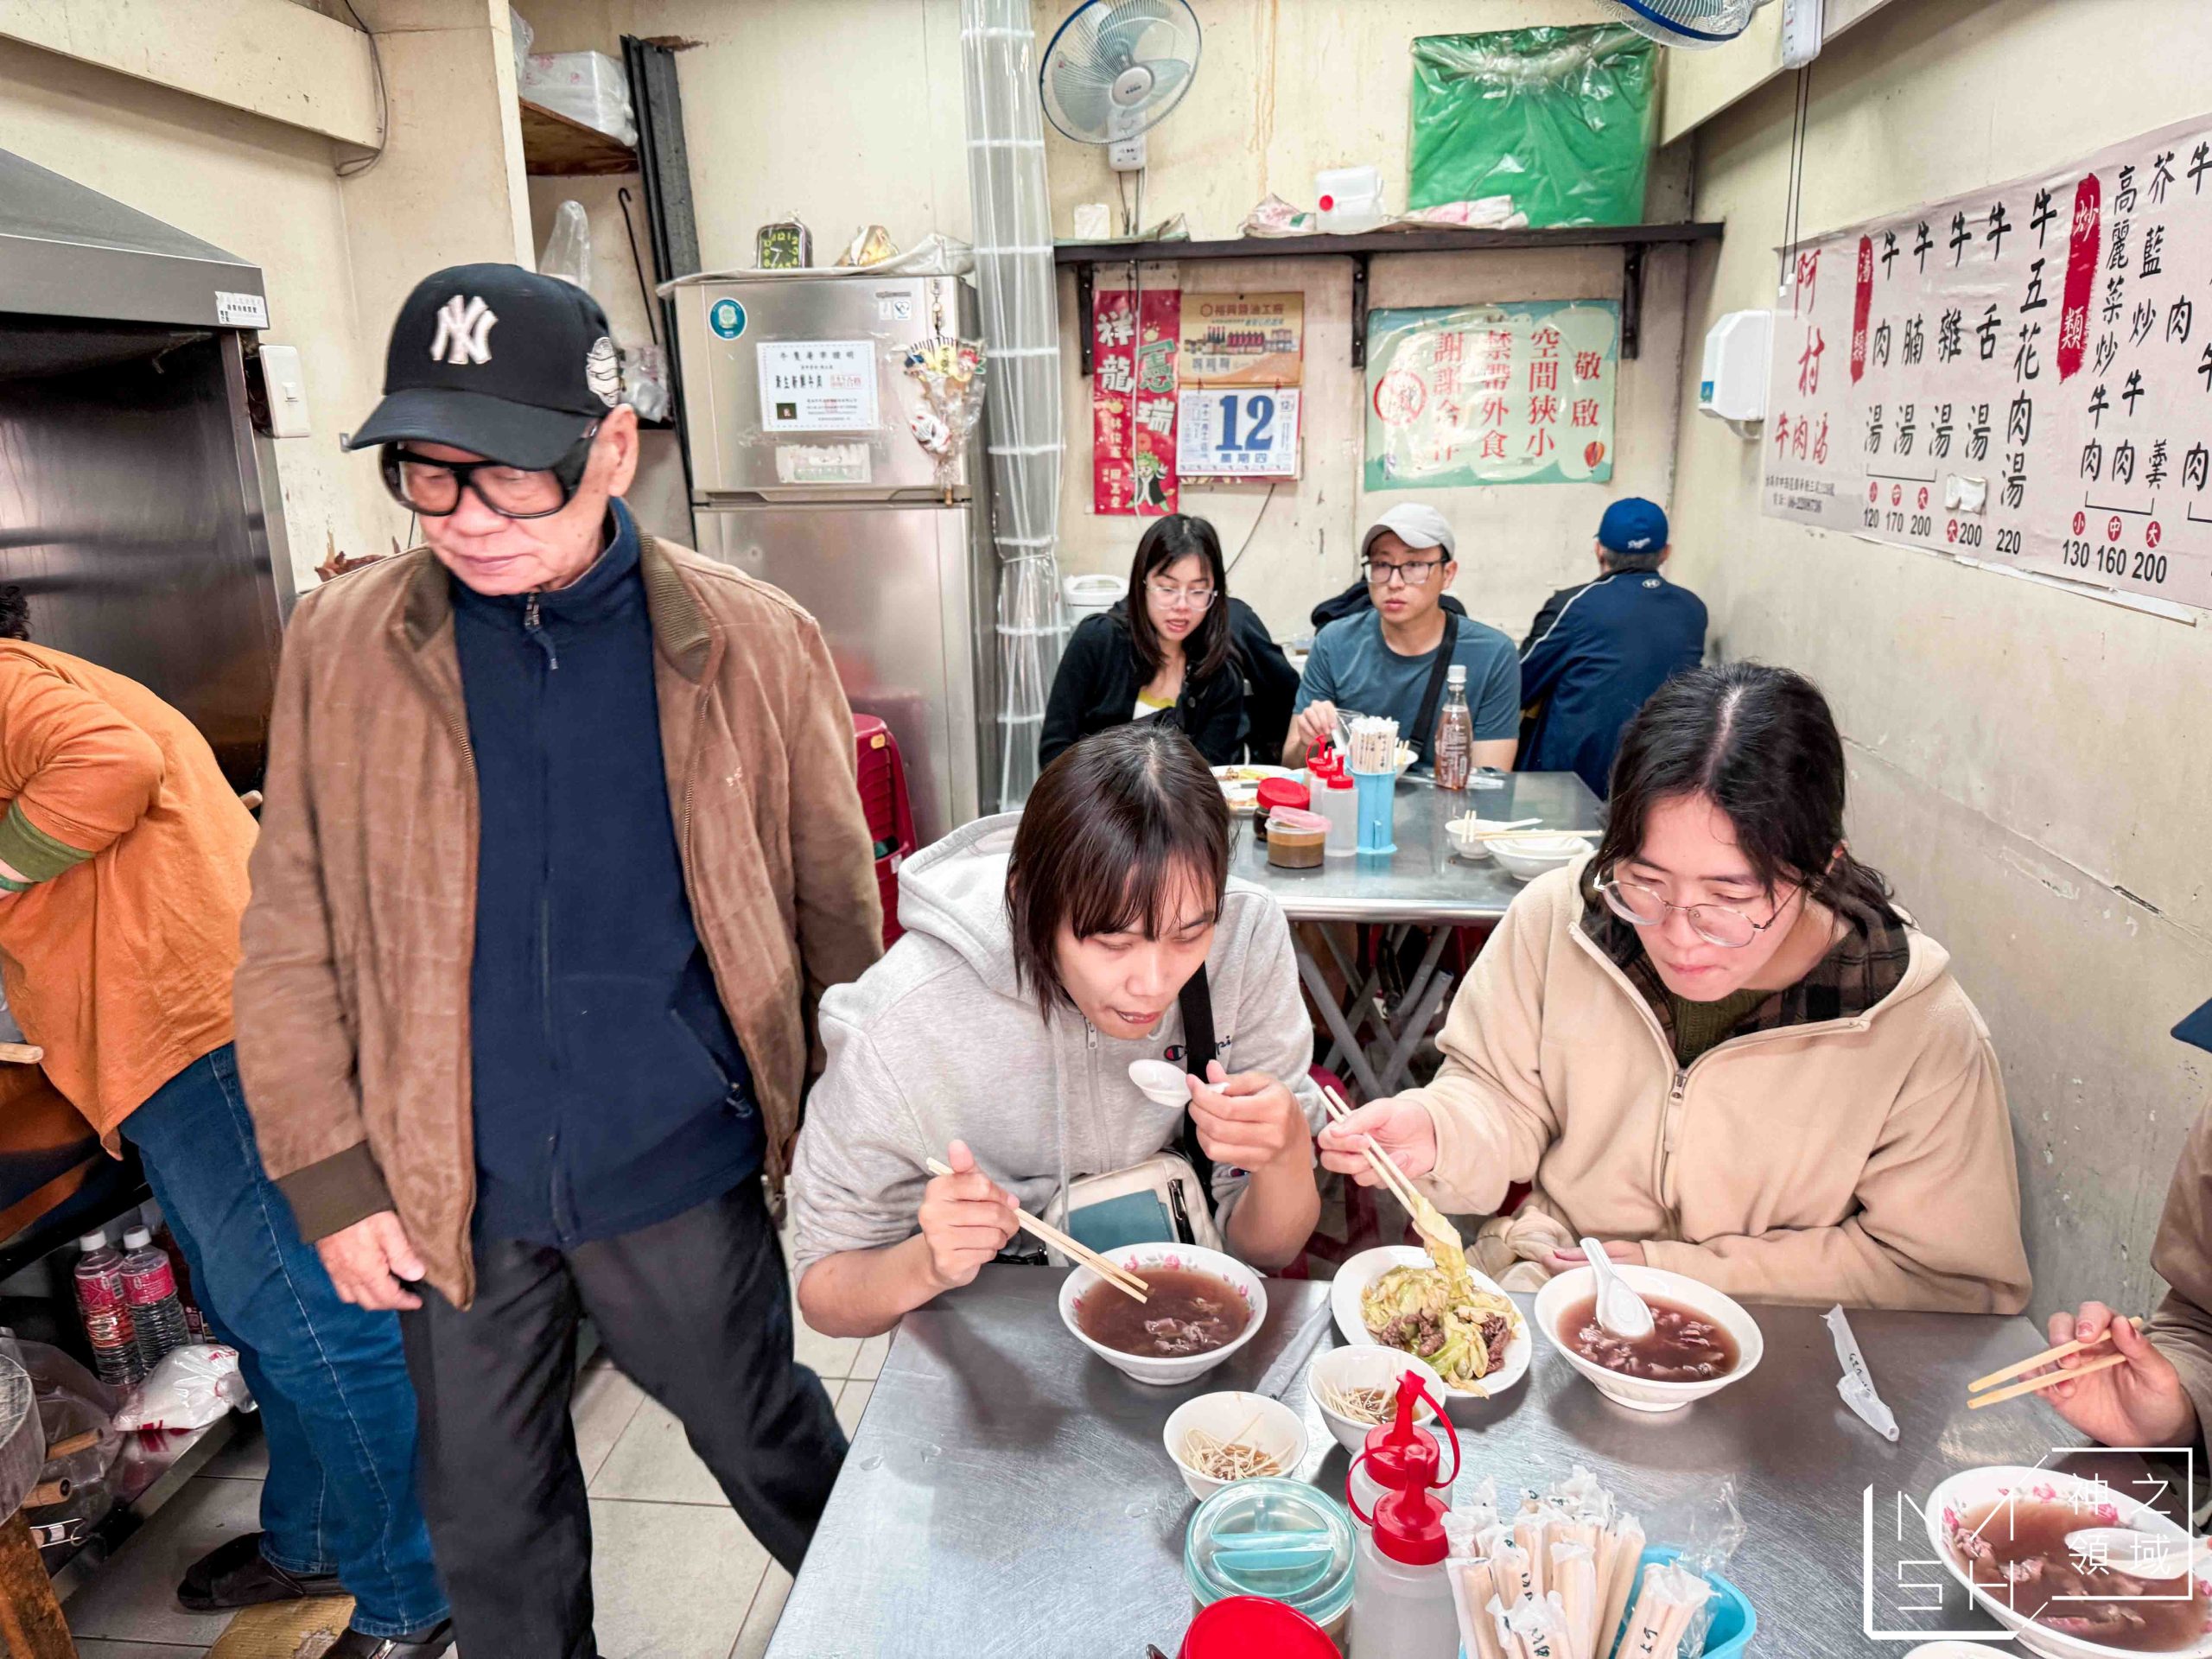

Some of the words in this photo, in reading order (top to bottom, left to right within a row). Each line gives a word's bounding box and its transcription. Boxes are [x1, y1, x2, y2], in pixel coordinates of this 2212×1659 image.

[2060, 194, 2100, 349] 炒類
[431, 295, 499, 365] NY
[1794, 248, 1825, 397] 阿村
[1864, 230, 1899, 454] 牛肉湯
[1893, 220, 1934, 456] 牛腩湯
[1929, 211, 1972, 459] 牛雜湯
[1965, 201, 2012, 461] 牛舌湯
[2000, 188, 2058, 509] 牛五花肉湯
[2080, 165, 2138, 482] 高麗菜炒牛肉
[2112, 150, 2176, 485] 芥藍炒牛肉
[1215, 395, 1275, 452] 12
[1479, 329, 1512, 460] 禁帶外食
[1526, 327, 1560, 458] 空間狹小
[1570, 350, 1603, 428] 敬啟
[1220, 453, 1268, 464] 星期四
[1775, 411, 1828, 465] 牛肉湯
[1864, 508, 1880, 529] 120
[1886, 512, 1904, 533] 170
[1910, 515, 1932, 537] 200
[1959, 522, 1983, 548] 200
[1995, 528, 2022, 556] 220
[2107, 516, 2122, 541] 中
[2145, 521, 2161, 548] 大
[2062, 539, 2090, 568] 130
[2097, 545, 2127, 576] 160
[2132, 551, 2167, 584] 200
